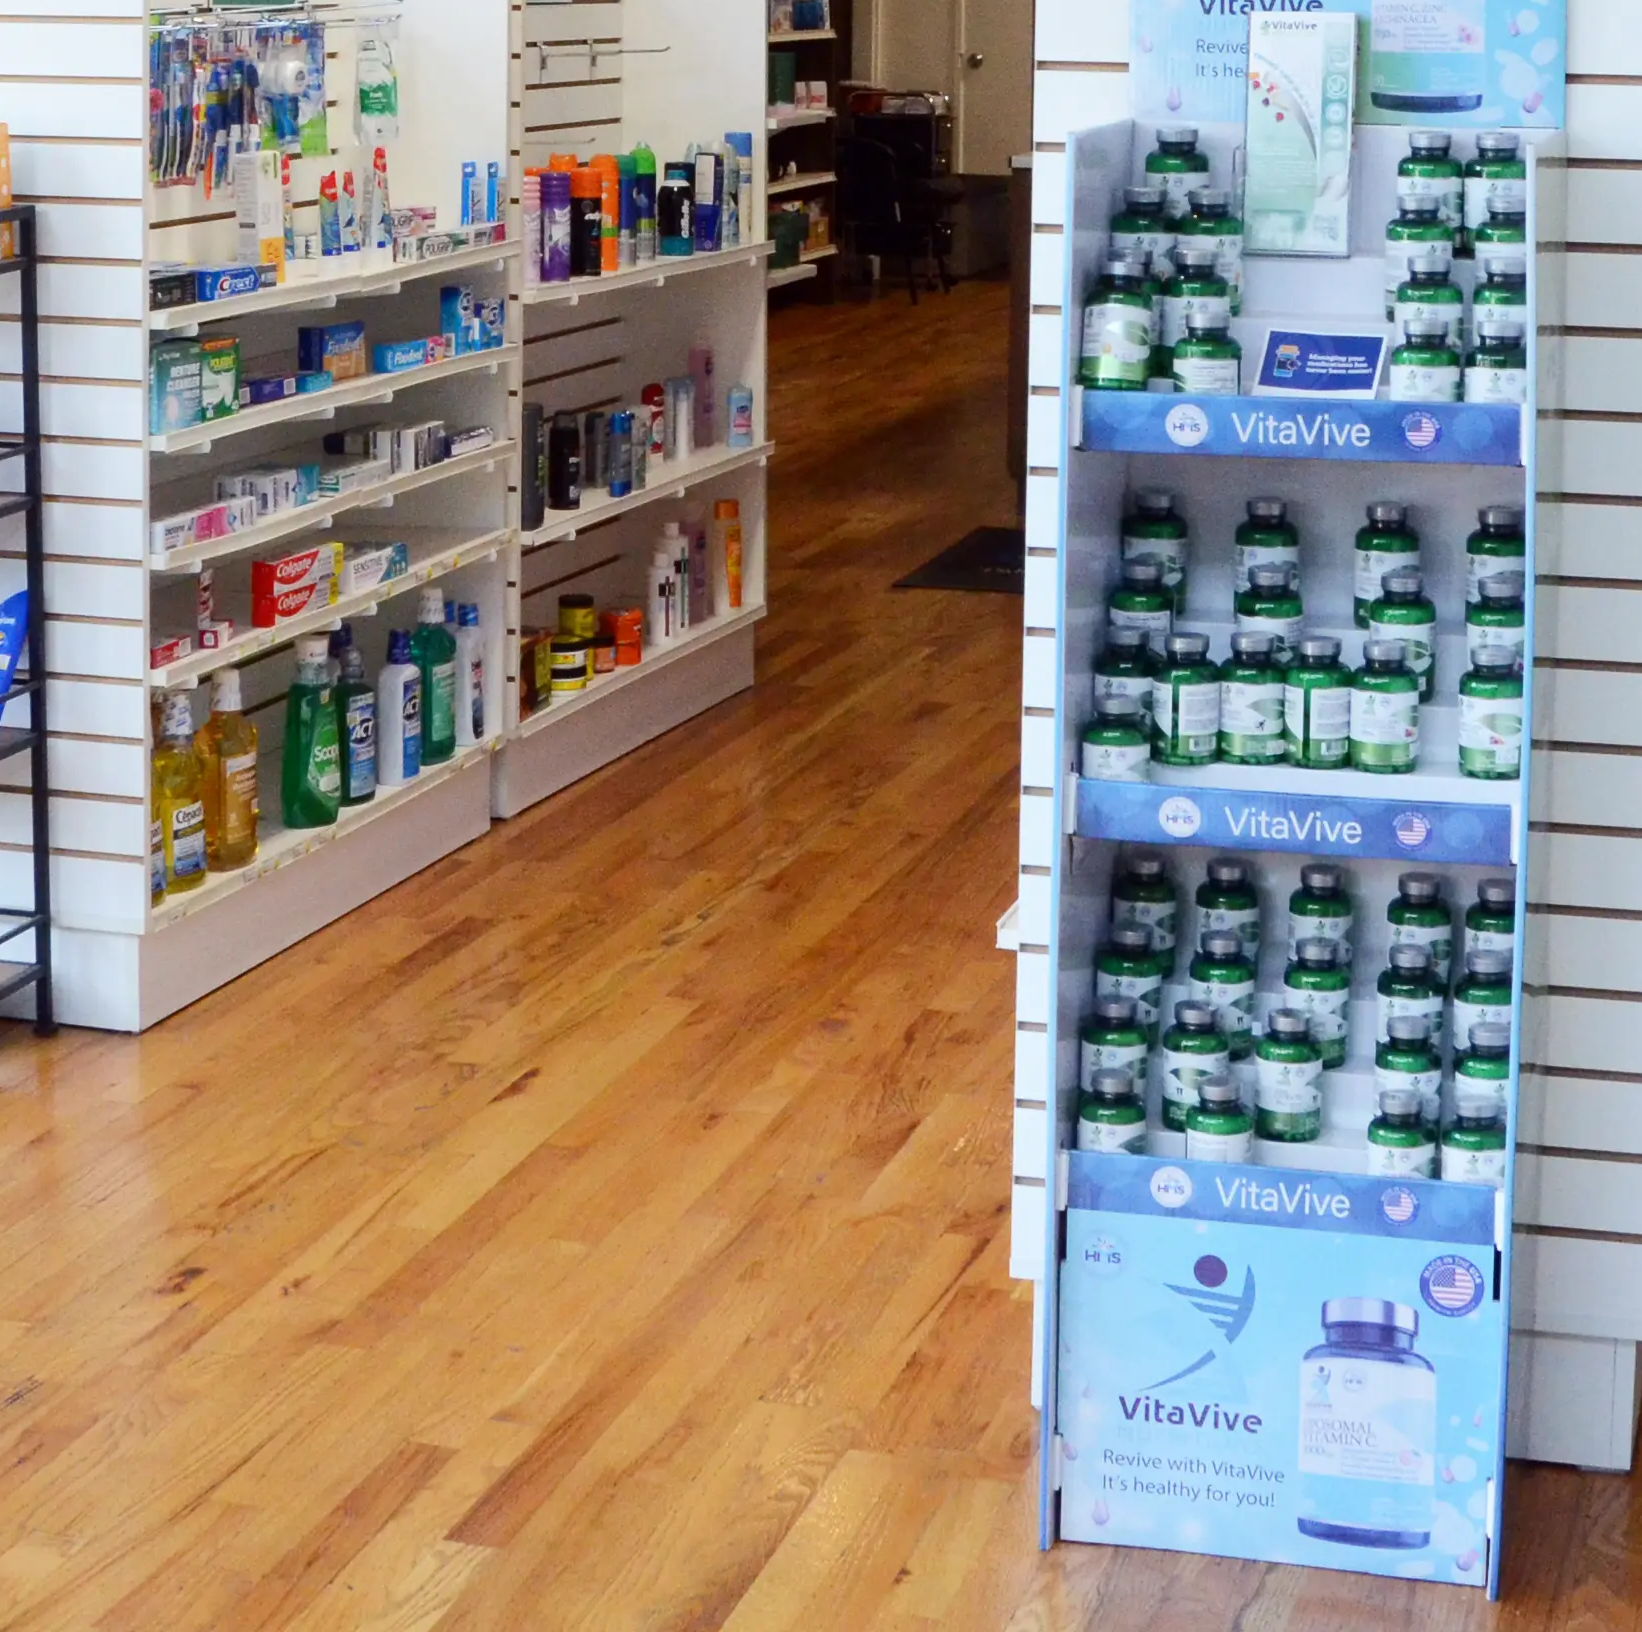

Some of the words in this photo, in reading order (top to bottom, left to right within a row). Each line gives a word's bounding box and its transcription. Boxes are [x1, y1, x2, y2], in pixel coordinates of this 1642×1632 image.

[1272, 21, 1318, 31] VitaVive
[1195, 39, 1248, 55] Revive
[1195, 63, 1218, 78] It's
[219, 270, 256, 293] Crest
[1231, 411, 1371, 447] VitaVive
[276, 557, 313, 580] Colgate
[353, 554, 384, 574] SENSITIVE
[277, 589, 312, 612] Colgate
[350, 721, 375, 740] ACT
[1224, 806, 1362, 844] VitaVive
[1215, 1176, 1351, 1218] VitaVive
[1118, 1395, 1263, 1435] VitaVive
[1103, 1448, 1162, 1470] Revive
[1168, 1455, 1208, 1475] with
[1212, 1460, 1286, 1484] VitaVive
[1103, 1474, 1128, 1492] It's
[1133, 1477, 1201, 1504] healthy
[1205, 1485, 1231, 1503] for
[1235, 1491, 1276, 1508] you!
